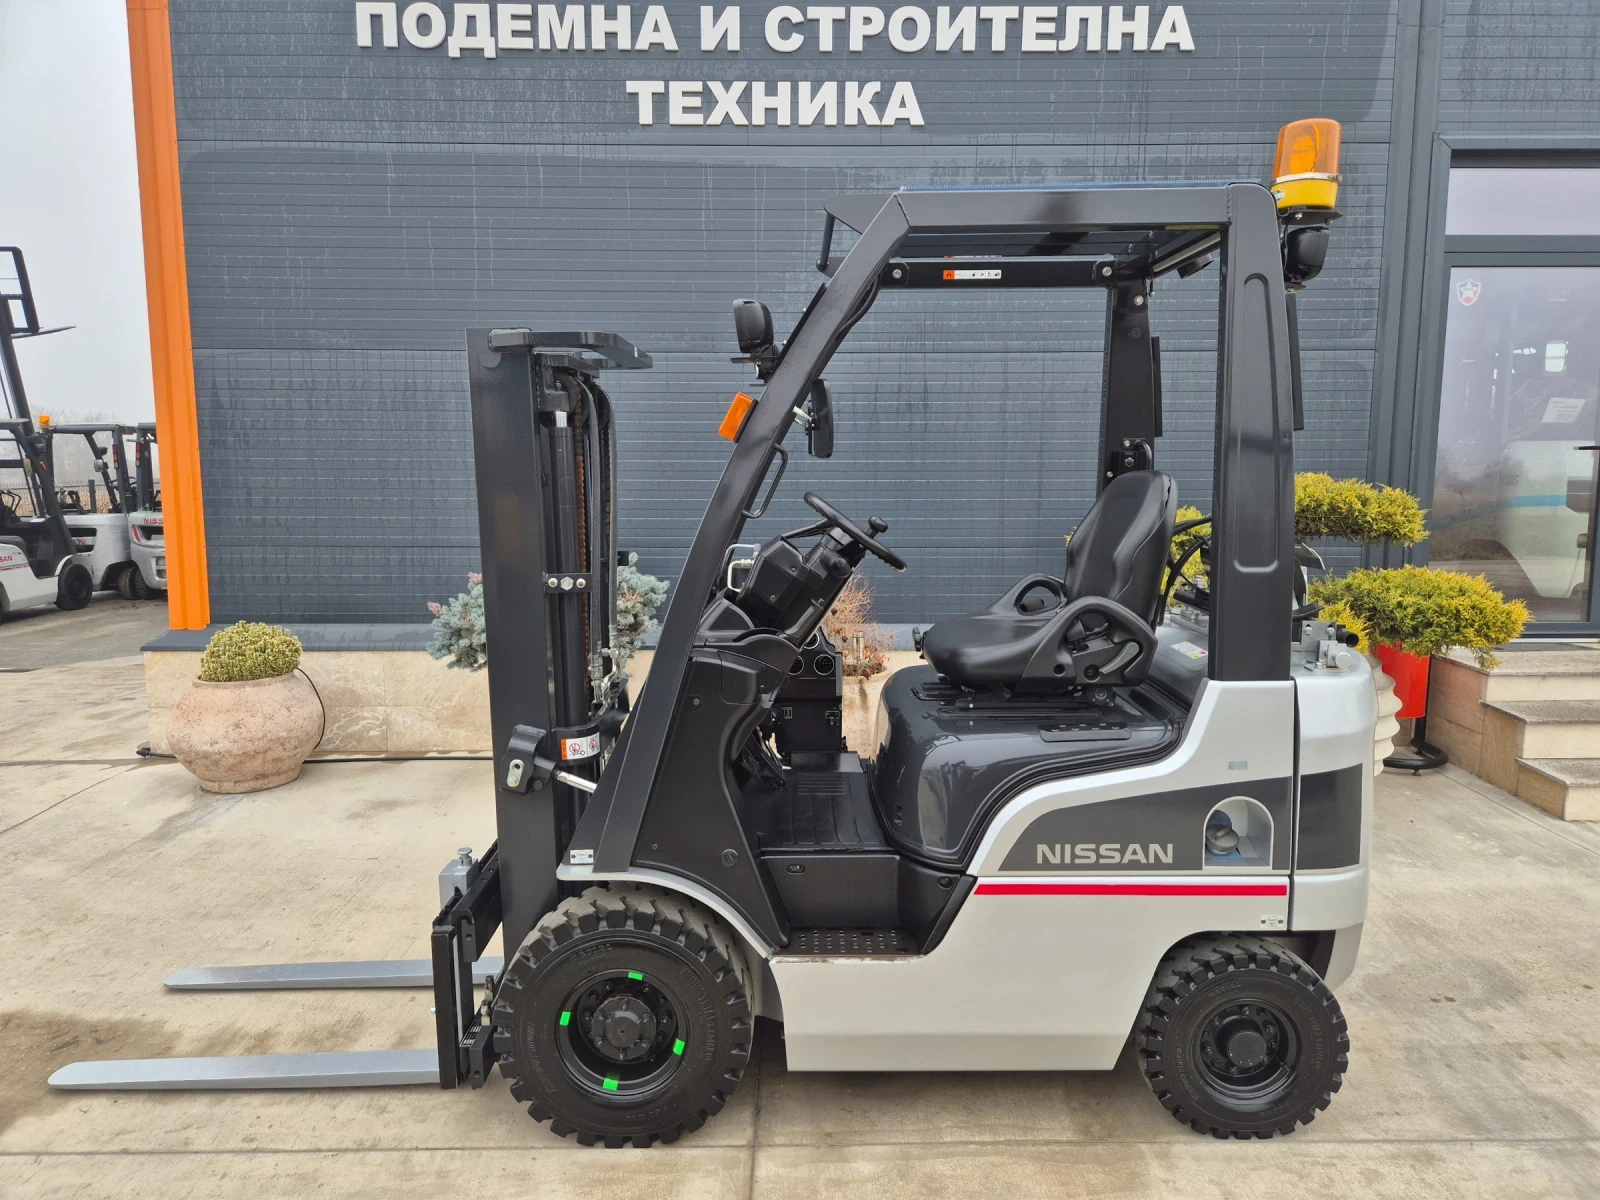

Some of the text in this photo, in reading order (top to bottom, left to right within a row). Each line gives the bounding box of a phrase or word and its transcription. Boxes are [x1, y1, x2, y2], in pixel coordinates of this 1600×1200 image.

[355, 1, 1196, 59] ПОДЕМНА И СТРОИТЕЛНА
[625, 80, 925, 126] ТЕХНИКА
[144, 517, 164, 525] NISS
[1036, 843, 1174, 864] NISSAN
